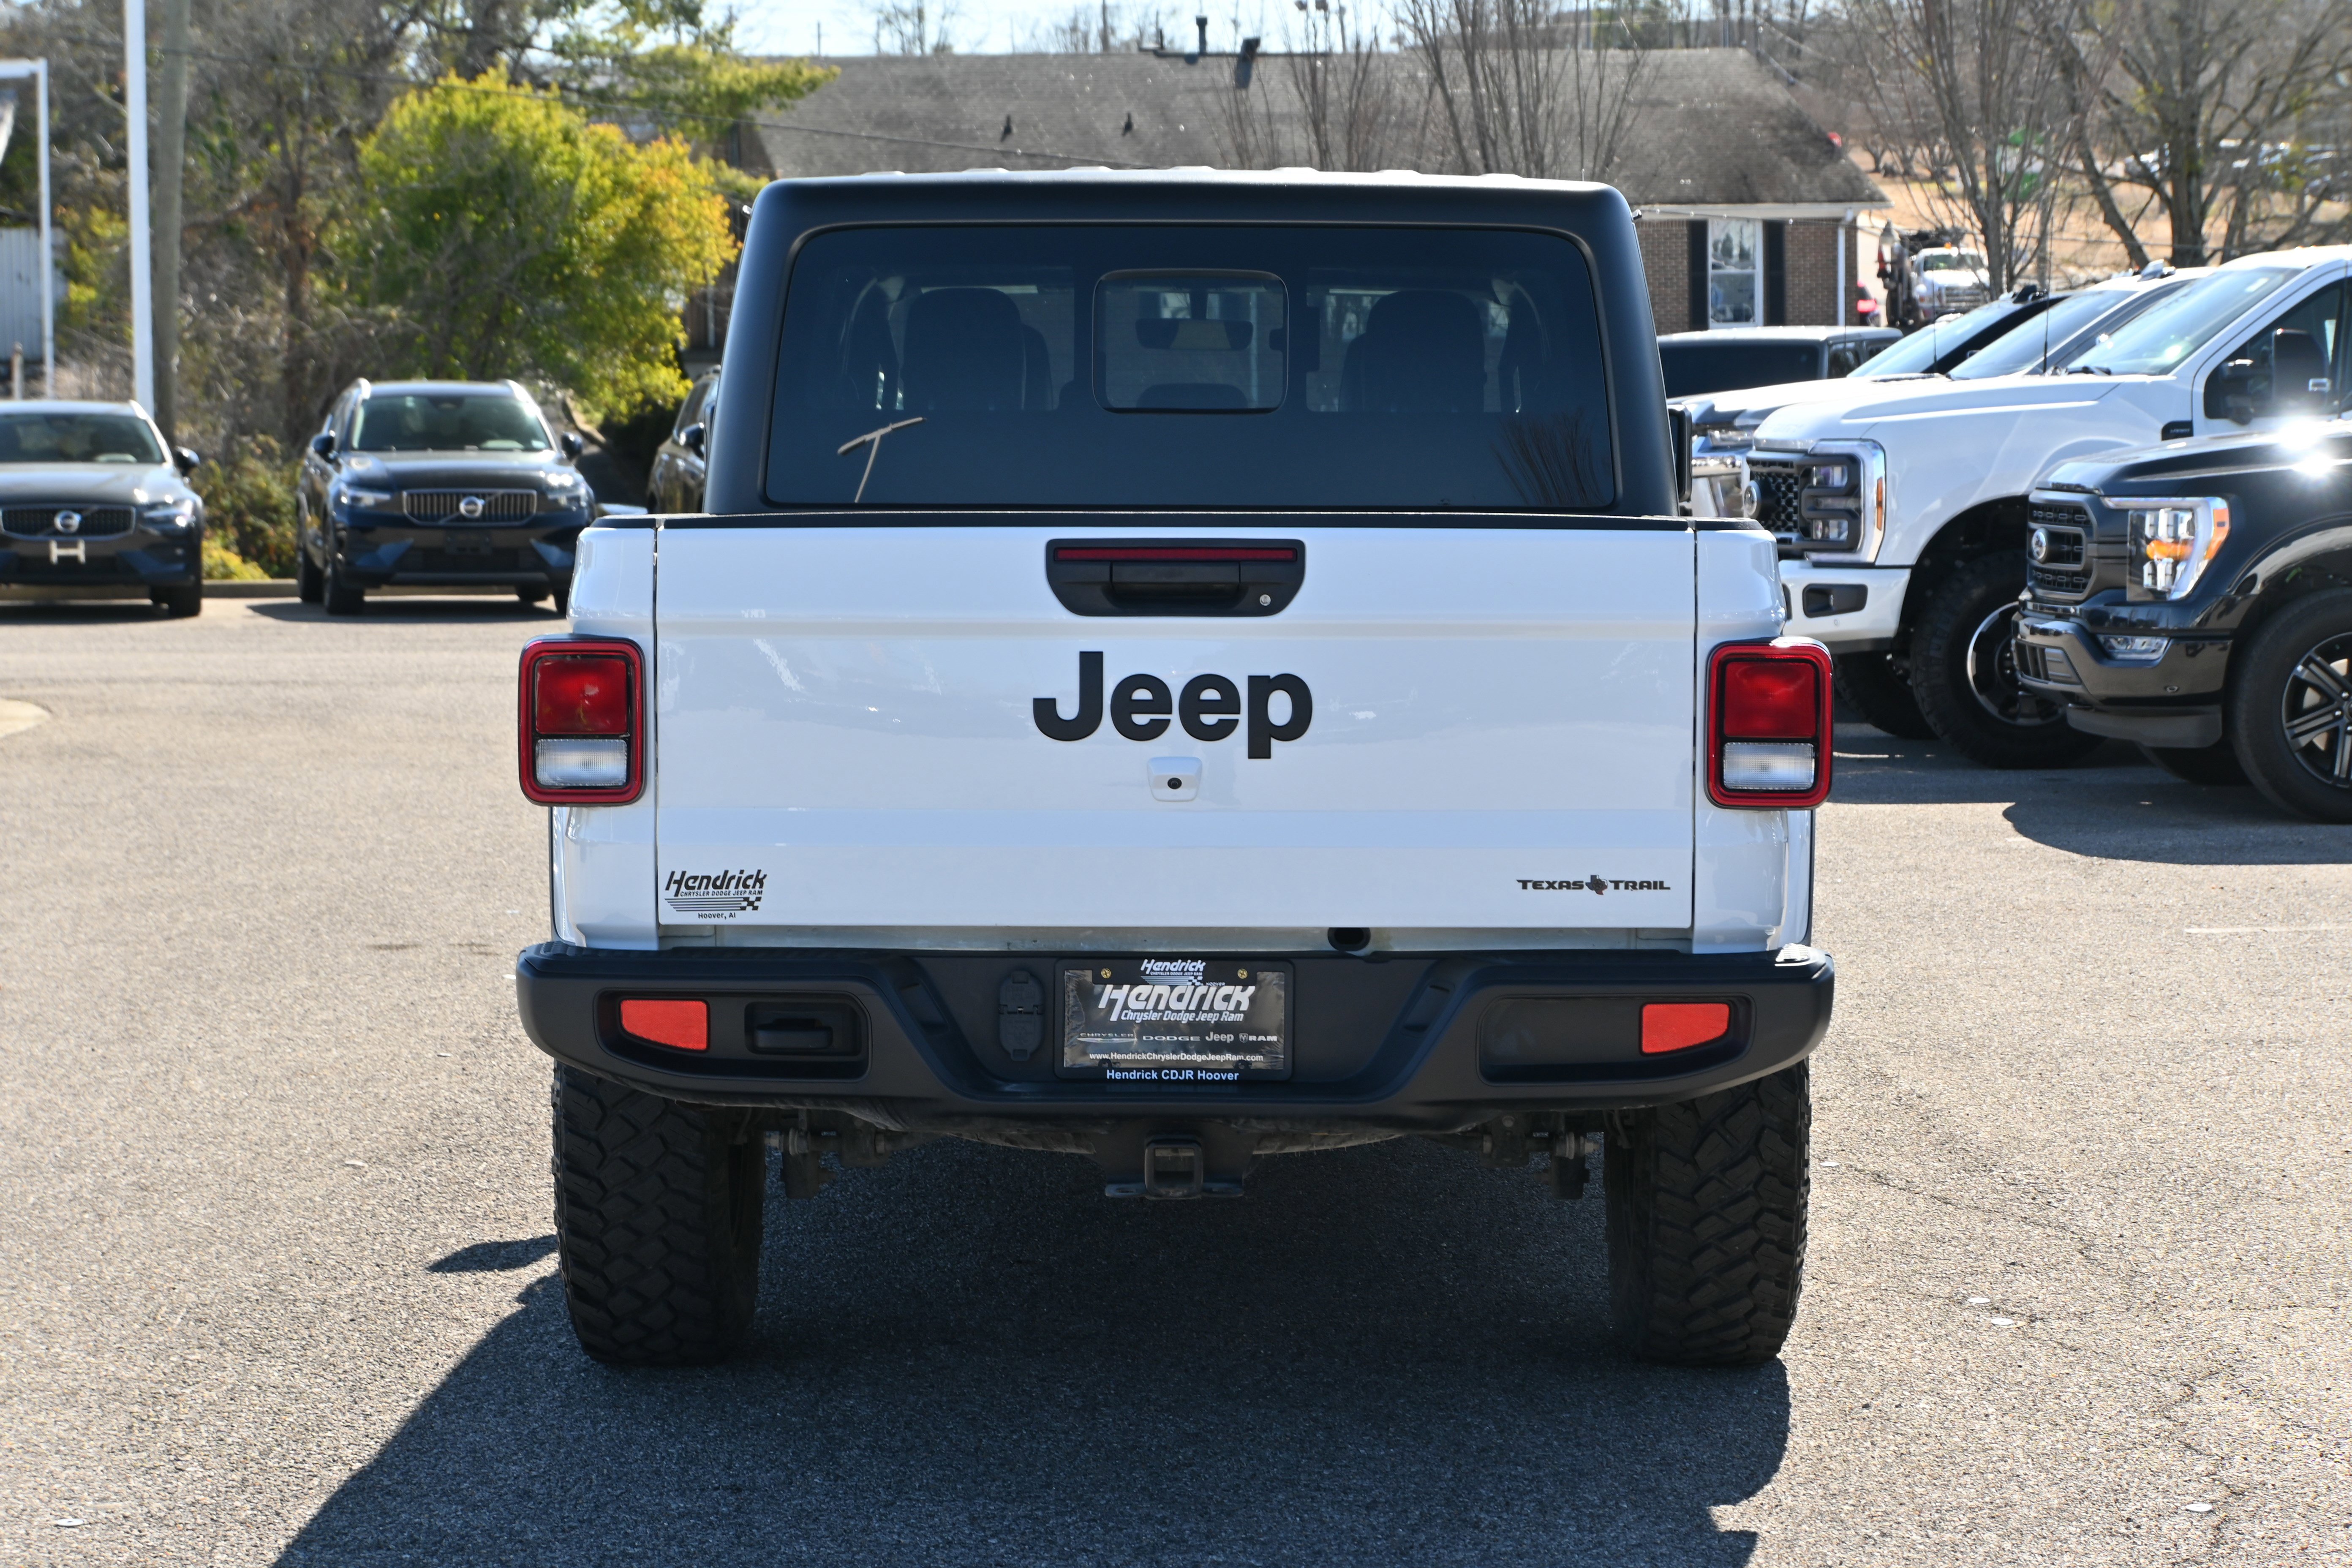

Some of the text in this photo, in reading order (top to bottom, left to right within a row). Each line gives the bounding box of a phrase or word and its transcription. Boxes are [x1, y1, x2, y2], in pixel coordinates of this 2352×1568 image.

[1033, 651, 1313, 759] Jeep
[665, 869, 767, 897] Hendrick
[1516, 879, 1671, 891] TEXAS TRAIL
[1141, 959, 1206, 974] Hendrick
[1098, 985, 1255, 1021] Hendrick
[1121, 1010, 1244, 1024] Chrysler Dodge Jeep Ram
[1205, 1032, 1234, 1043] Jeep
[1089, 1052, 1263, 1062] www.HendrickChryslerDodgeJeepRam.com
[1106, 1070, 1239, 1080] Hendrick CDJR Hoover
